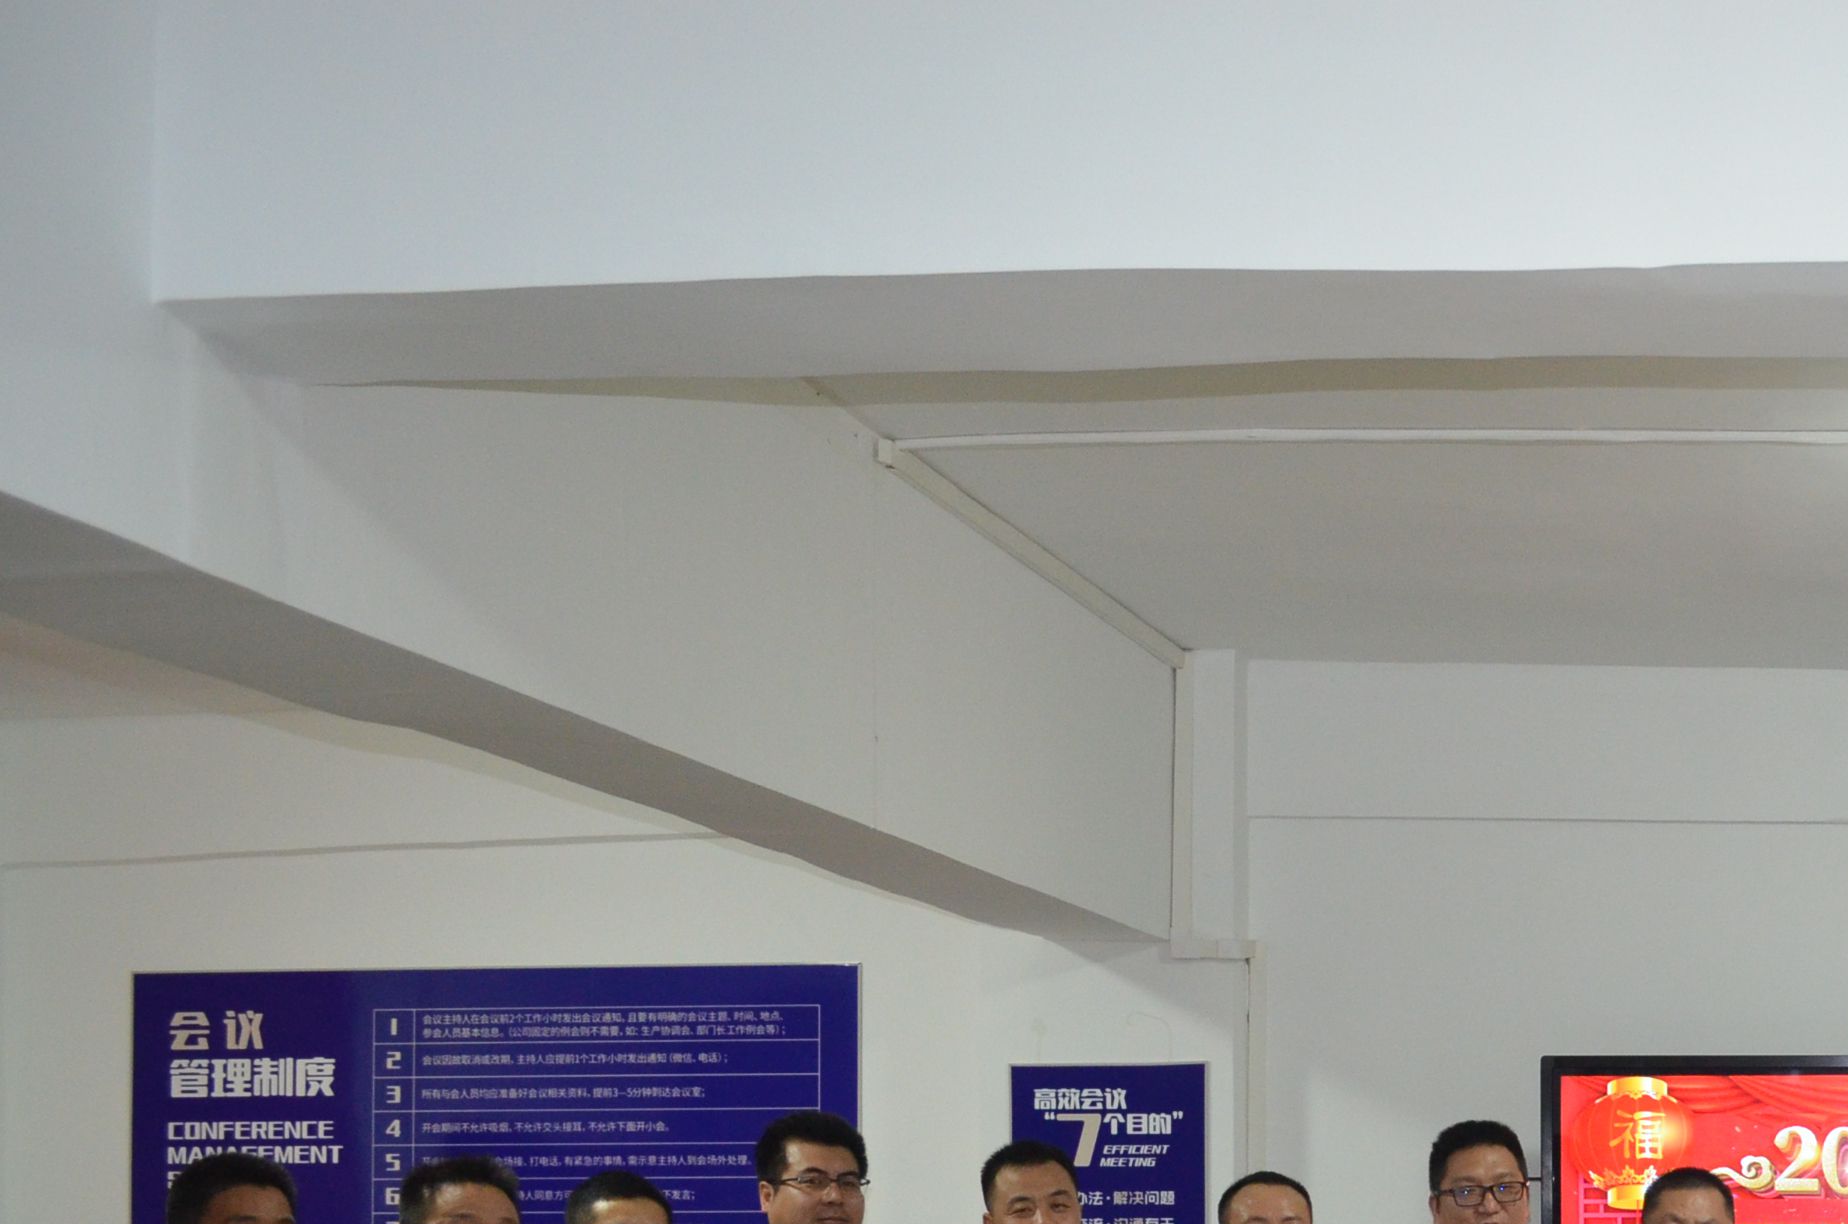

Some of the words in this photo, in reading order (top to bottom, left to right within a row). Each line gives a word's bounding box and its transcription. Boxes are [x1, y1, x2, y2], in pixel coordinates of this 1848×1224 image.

[169, 1010, 264, 1050] 会议
[390, 1018, 398, 1036] 1
[385, 1051, 402, 1069] 2
[169, 1057, 336, 1098] 管理制度
[385, 1085, 402, 1103] 3
[1033, 1088, 1127, 1110] 高效会议
[167, 1121, 334, 1140] CONFERENCE
[385, 1119, 401, 1137] 4
[1609, 1110, 1666, 1160] 福
[1103, 1144, 1170, 1155] EFFICIENT
[385, 1153, 401, 1171] 5
[1100, 1157, 1156, 1167] MEETING
[385, 1187, 400, 1206] 6
